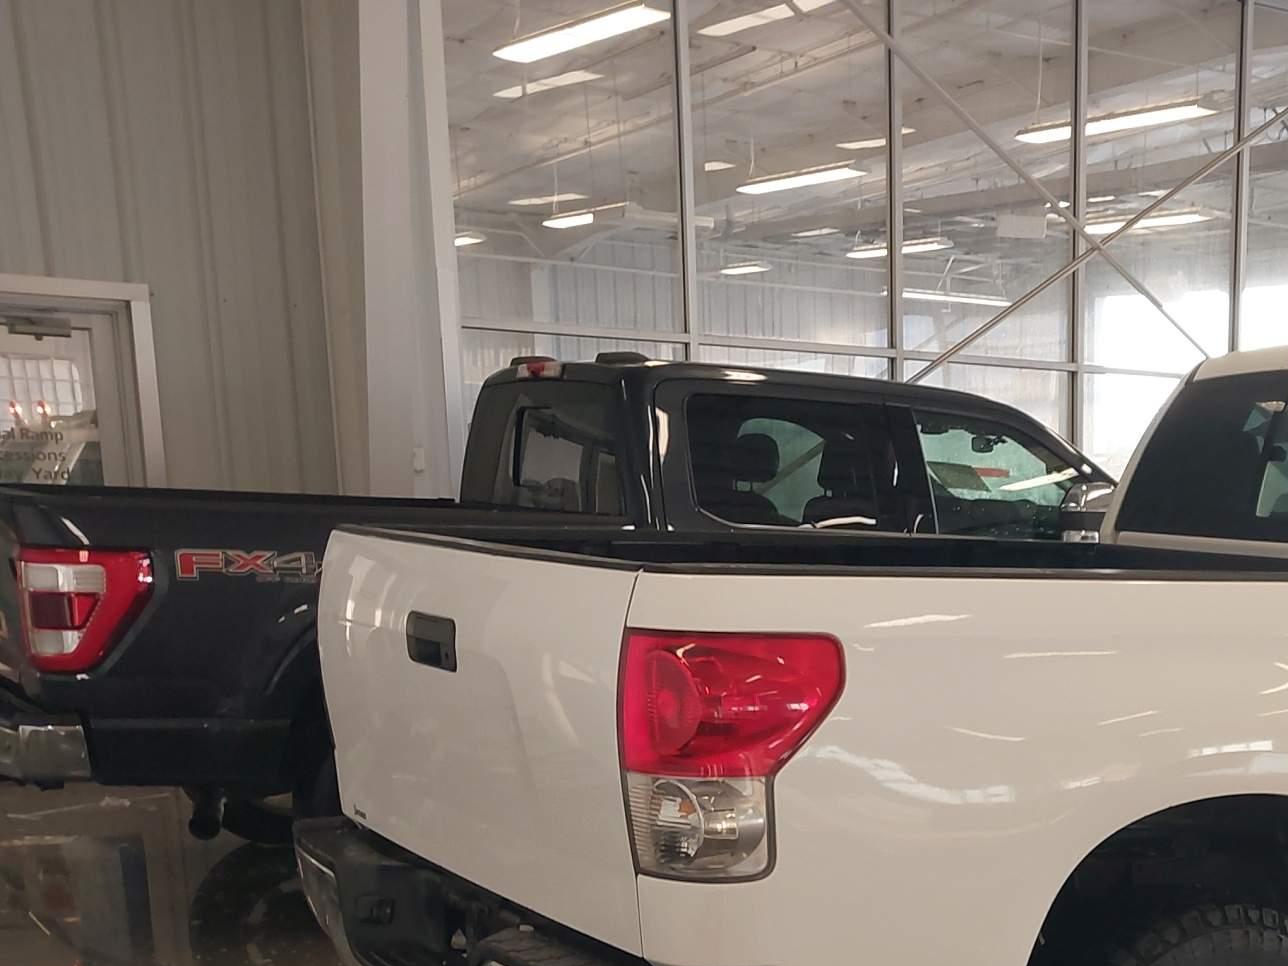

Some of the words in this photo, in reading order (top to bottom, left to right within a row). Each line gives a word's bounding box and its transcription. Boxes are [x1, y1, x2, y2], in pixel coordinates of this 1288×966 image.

[20, 428, 64, 445] Ramp
[32, 467, 70, 482] Yard
[174, 548, 316, 581] FX4
